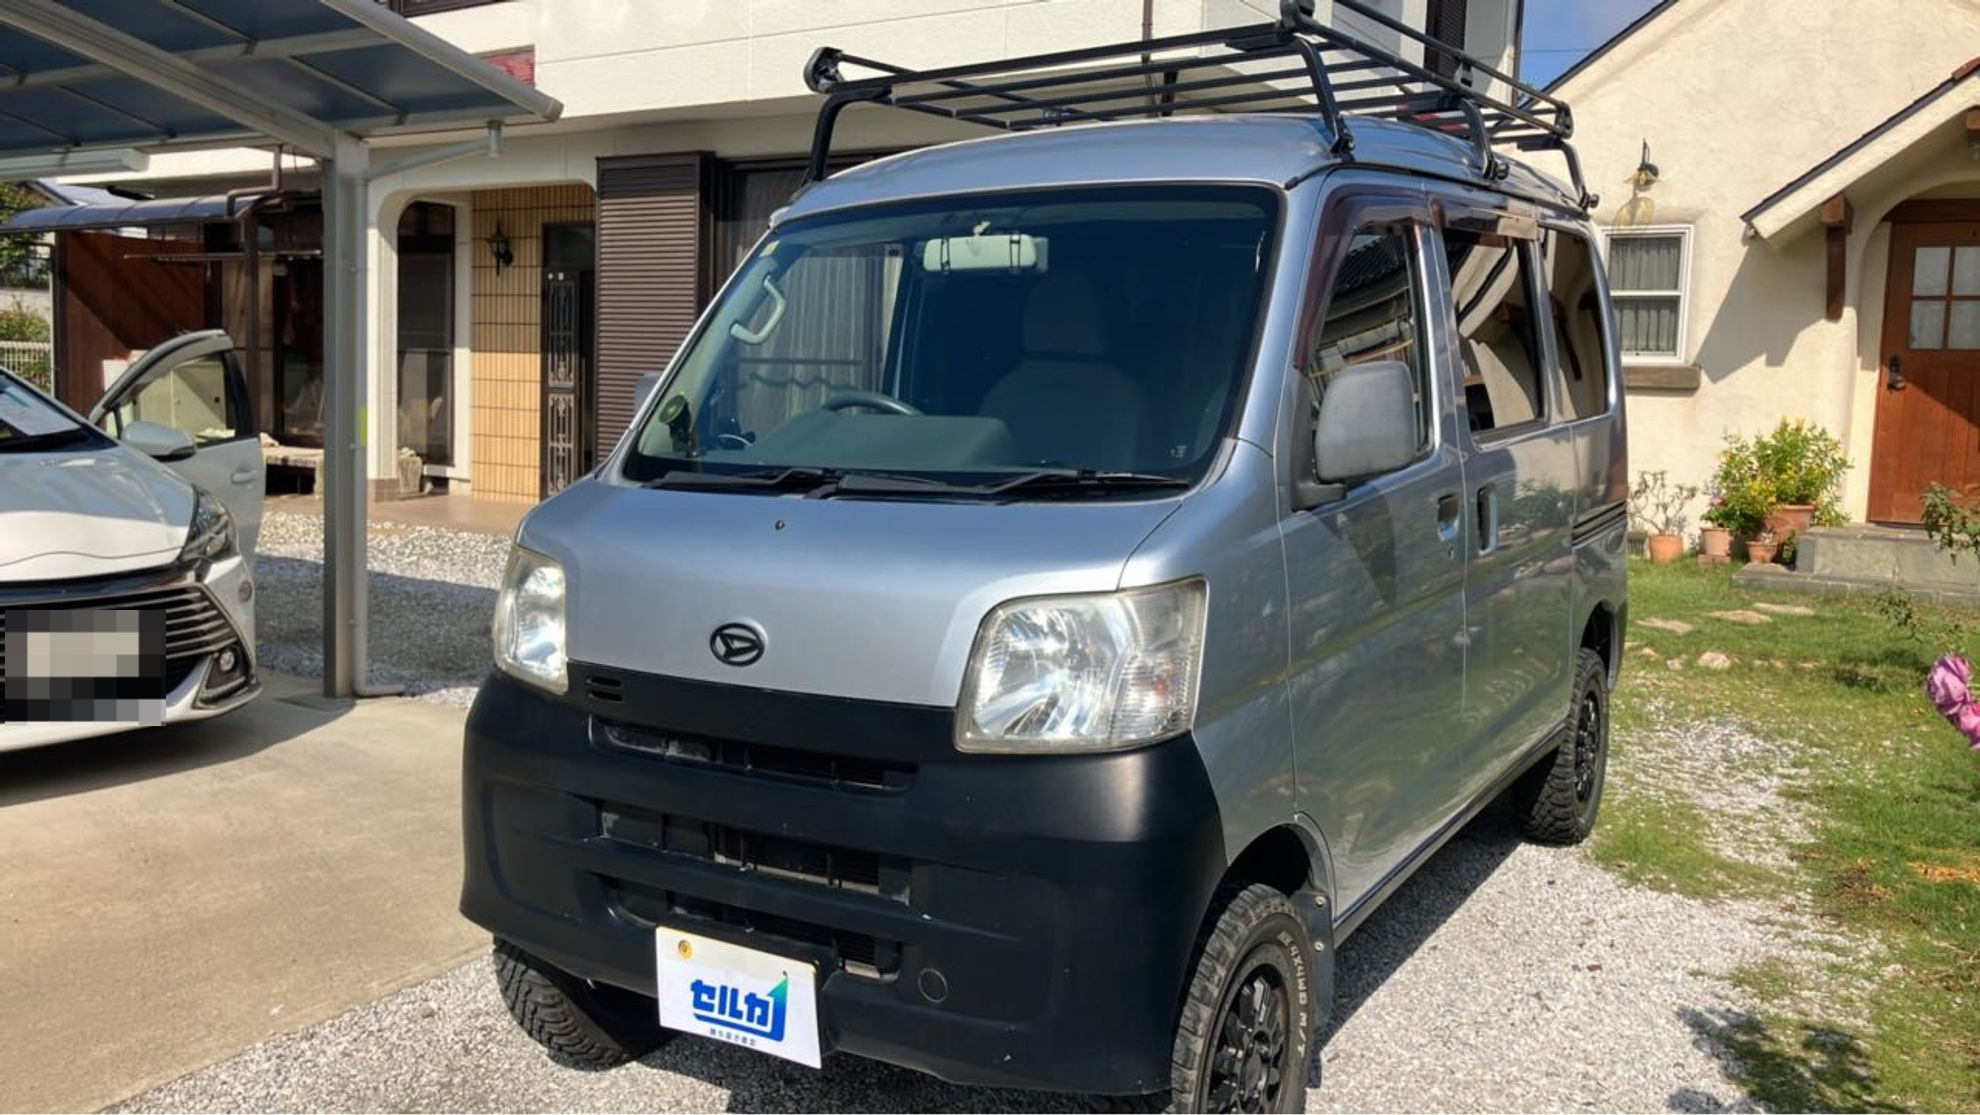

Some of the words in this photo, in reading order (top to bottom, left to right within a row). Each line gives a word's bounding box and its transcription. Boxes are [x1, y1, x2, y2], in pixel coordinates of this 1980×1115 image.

[690, 979, 770, 1027] セルカ
[1297, 1012, 1308, 1058] M/T
